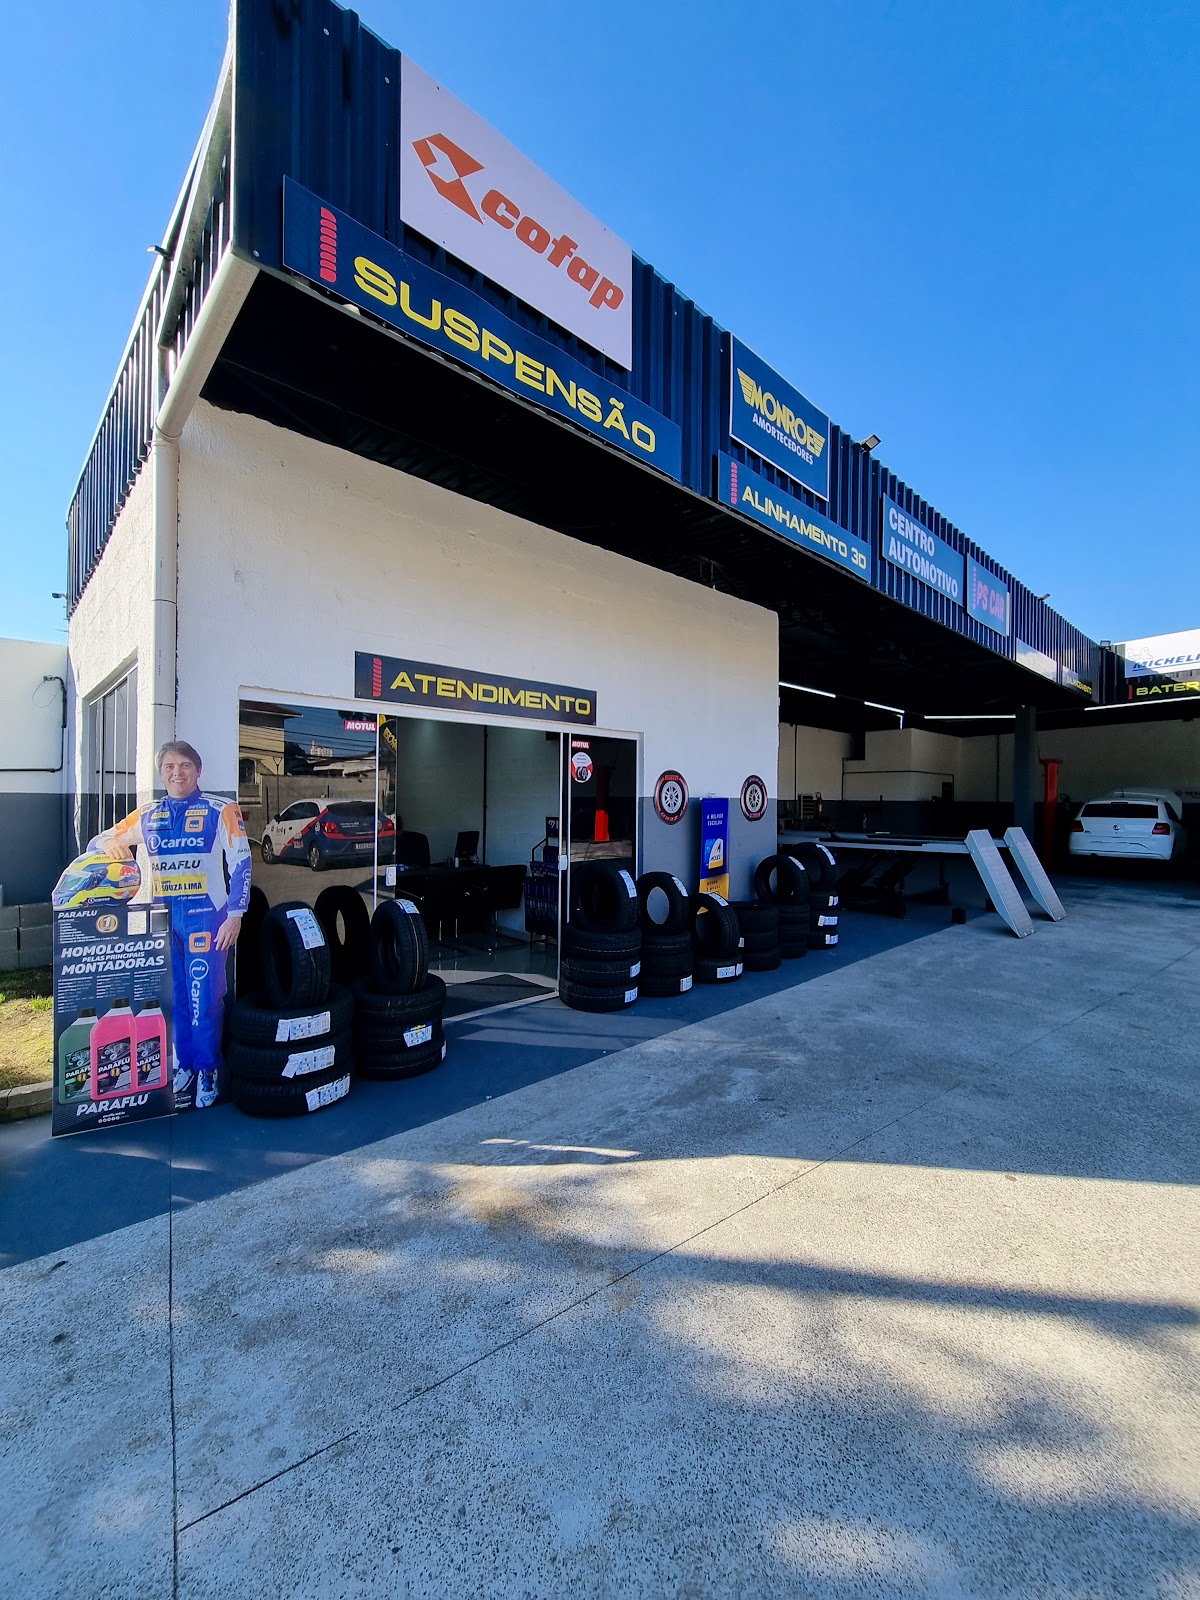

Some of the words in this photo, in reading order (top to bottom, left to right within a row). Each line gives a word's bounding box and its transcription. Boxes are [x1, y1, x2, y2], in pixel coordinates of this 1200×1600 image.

[480, 189, 624, 310] cofap
[354, 256, 656, 453] SUSPENSÃO
[746, 379, 822, 457] MONROE
[752, 412, 813, 466] AMORTECEDORES
[742, 486, 847, 558] ALINHAMENTO
[851, 549, 866, 570] 3D
[889, 507, 935, 557] CENTRO
[888, 537, 958, 598] AUTOMOTIVO
[977, 581, 988, 611] PS
[989, 590, 1005, 622] CAR
[390, 671, 591, 715] ATENDIMENTO
[347, 721, 376, 731] MOTUL
[572, 740, 590, 749] MOTUL
[152, 860, 201, 872] PARAFLU
[161, 884, 182, 893] SOUZA
[184, 882, 203, 890] LIMA
[58, 910, 98, 919] PARAFLU
[61, 939, 165, 958] HOMOLOGADO
[106, 951, 145, 960] PRINCIPAIS
[61, 956, 165, 975] MONTADORAS
[98, 1057, 131, 1073] PARAFLU
[76, 1094, 149, 1116] PARAFLU
